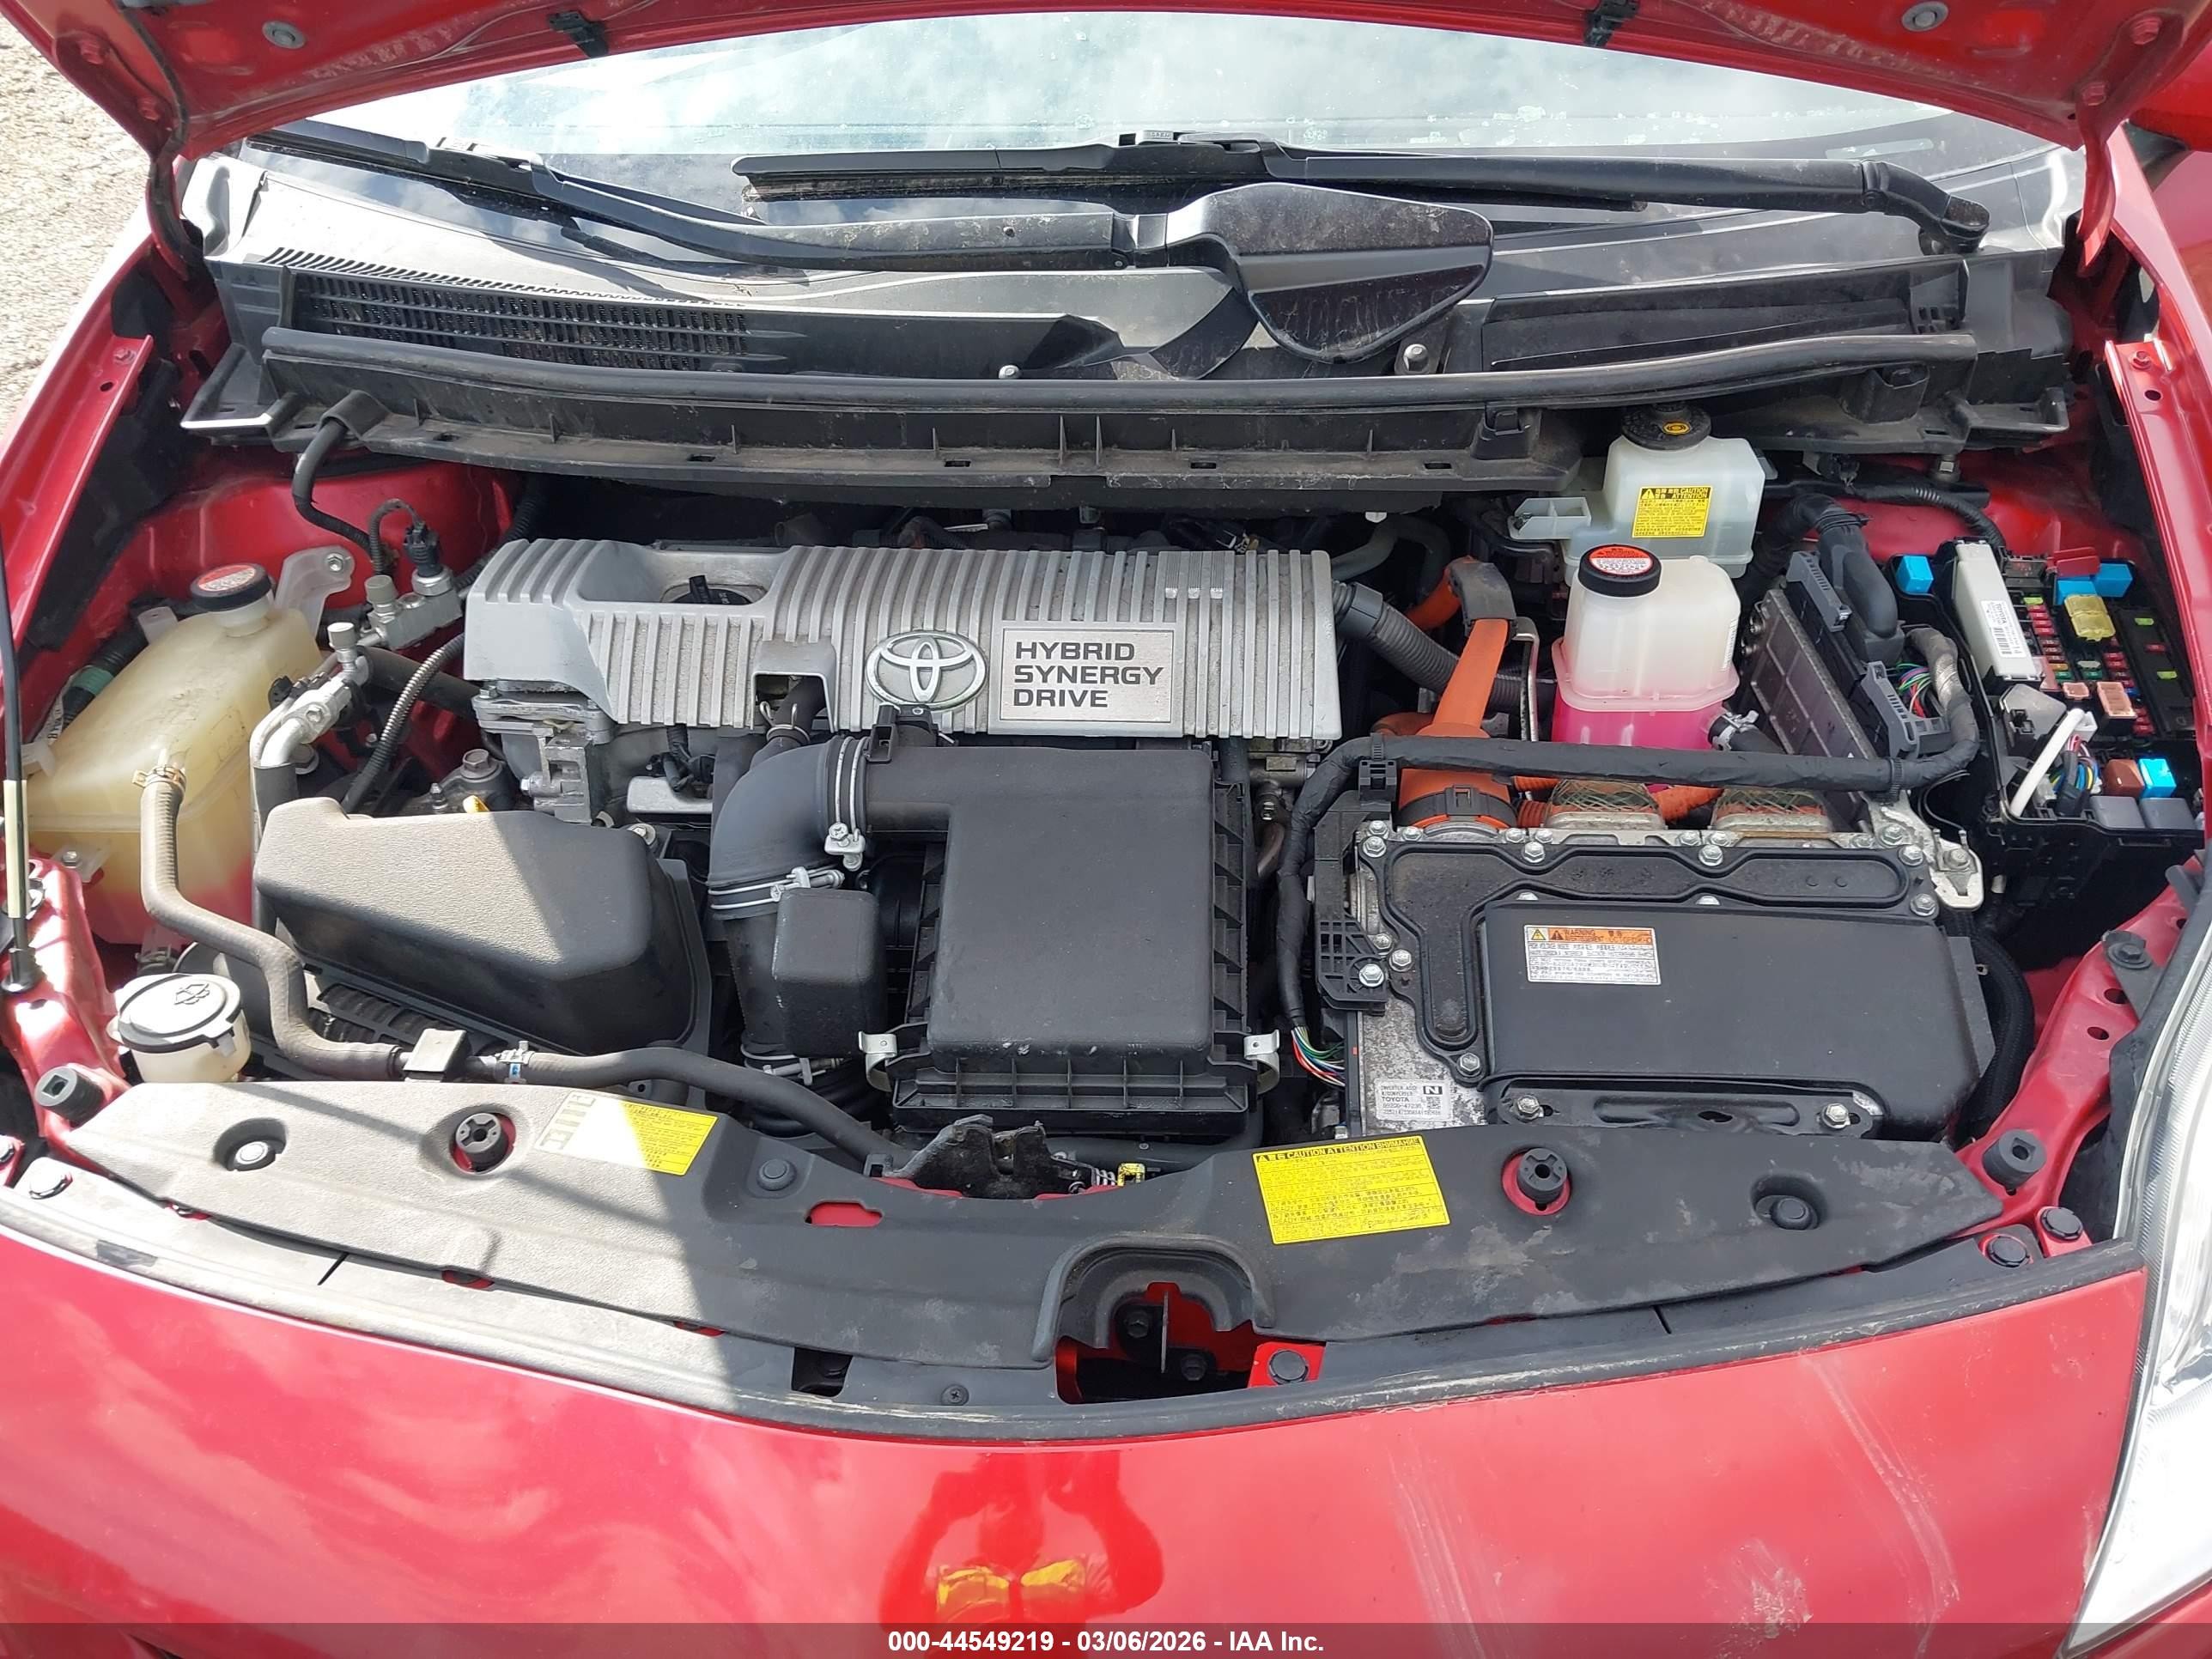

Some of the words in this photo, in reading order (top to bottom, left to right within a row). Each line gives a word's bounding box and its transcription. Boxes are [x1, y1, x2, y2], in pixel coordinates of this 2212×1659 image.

[1015, 641, 1135, 660] HYBRID
[1013, 665, 1164, 685] SYNERGY
[1012, 689, 1109, 708] DRIVE
[1288, 1147, 1326, 1159] CAUTION
[1326, 1142, 1376, 1155] ATTENTION
[1376, 1138, 1419, 1150] ВНИМАНИЕ
